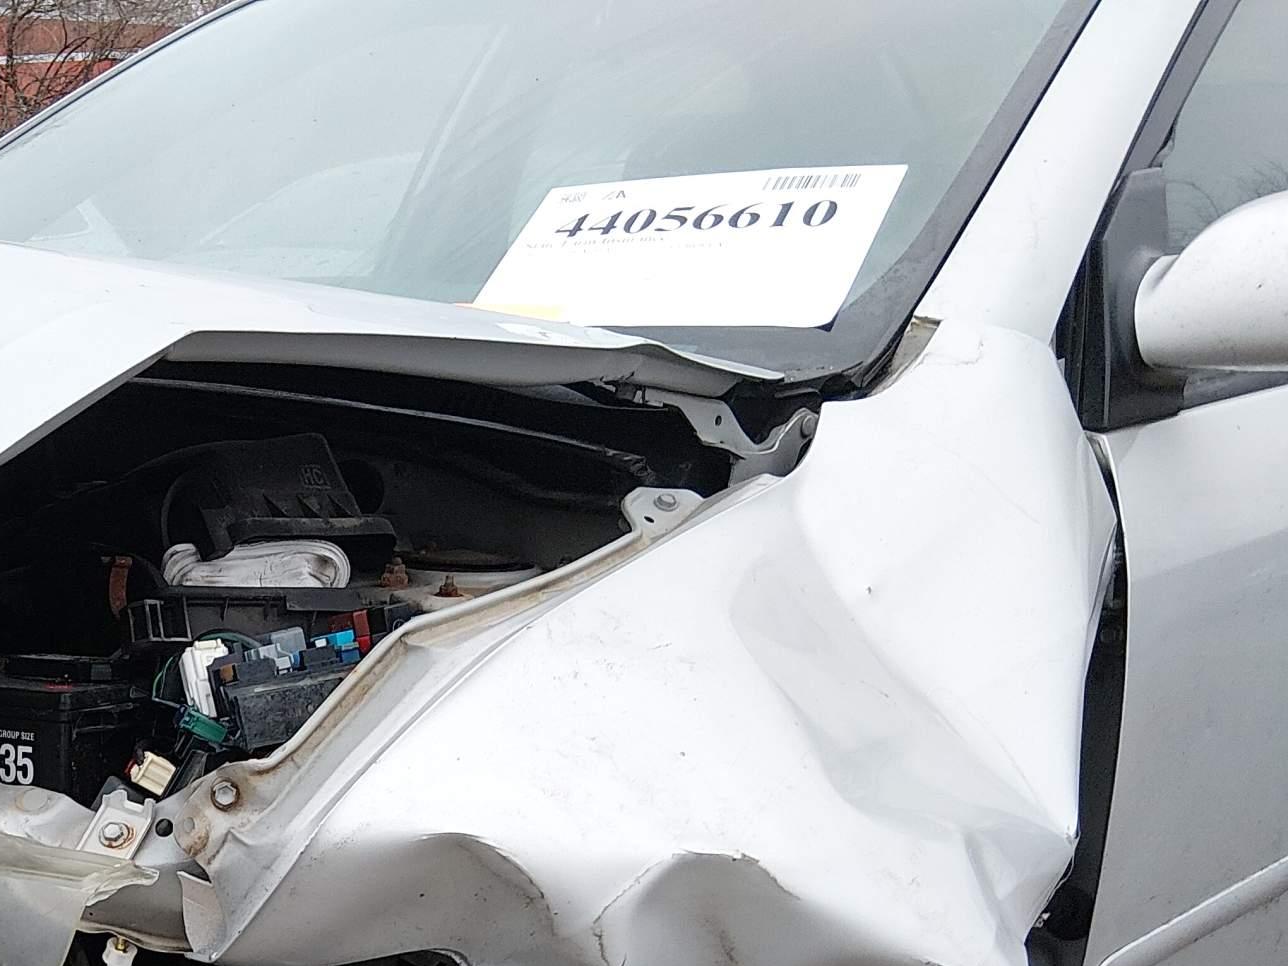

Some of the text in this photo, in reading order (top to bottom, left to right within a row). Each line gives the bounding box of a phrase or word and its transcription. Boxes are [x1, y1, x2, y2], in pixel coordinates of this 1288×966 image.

[555, 200, 839, 238] 44056610
[20, 731, 35, 741] SIZE
[0, 743, 34, 785] 35
